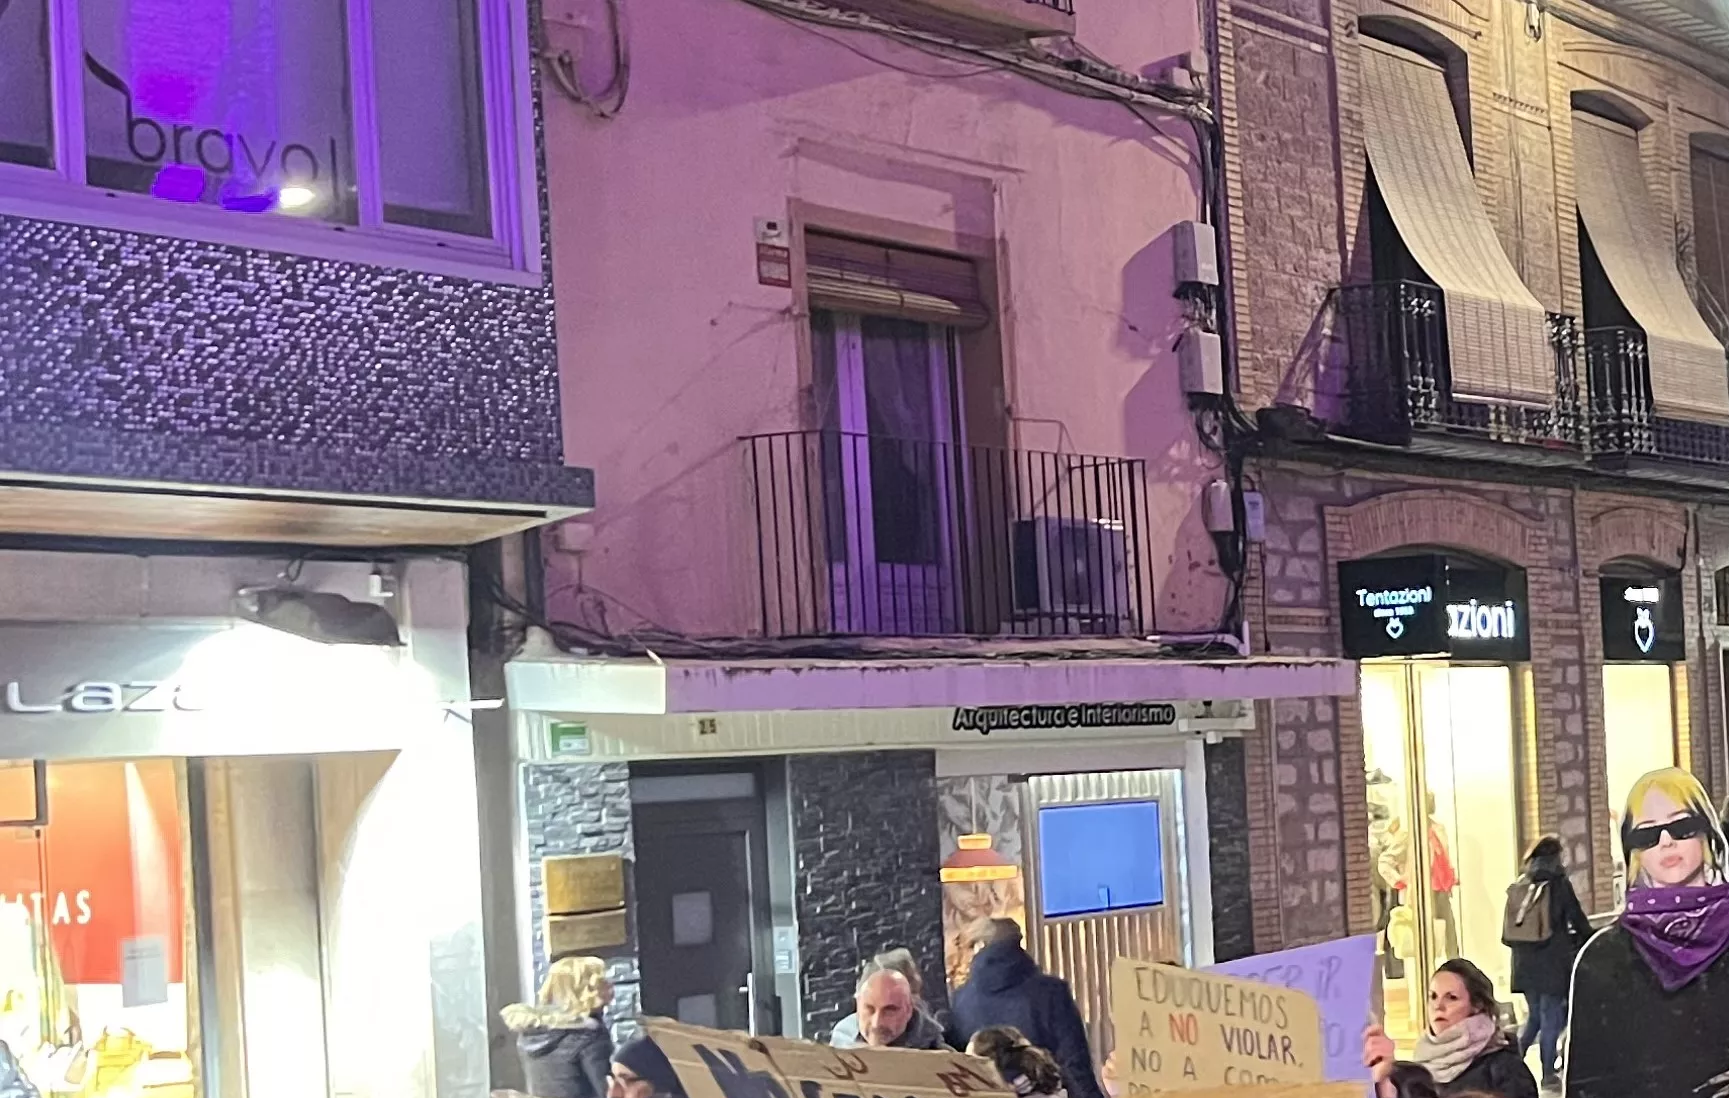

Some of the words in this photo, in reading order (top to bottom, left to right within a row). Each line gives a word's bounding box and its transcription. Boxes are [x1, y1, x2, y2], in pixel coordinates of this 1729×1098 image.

[1355, 585, 1433, 607] Tentazioni
[953, 706, 1066, 734] Arquitectura
[1066, 708, 1078, 727] e
[1080, 704, 1176, 726] Interiorismo
[1139, 1010, 1154, 1038] A
[1168, 1013, 1199, 1046] NO
[1130, 1046, 1163, 1073] NO
[1182, 1055, 1199, 1081] A
